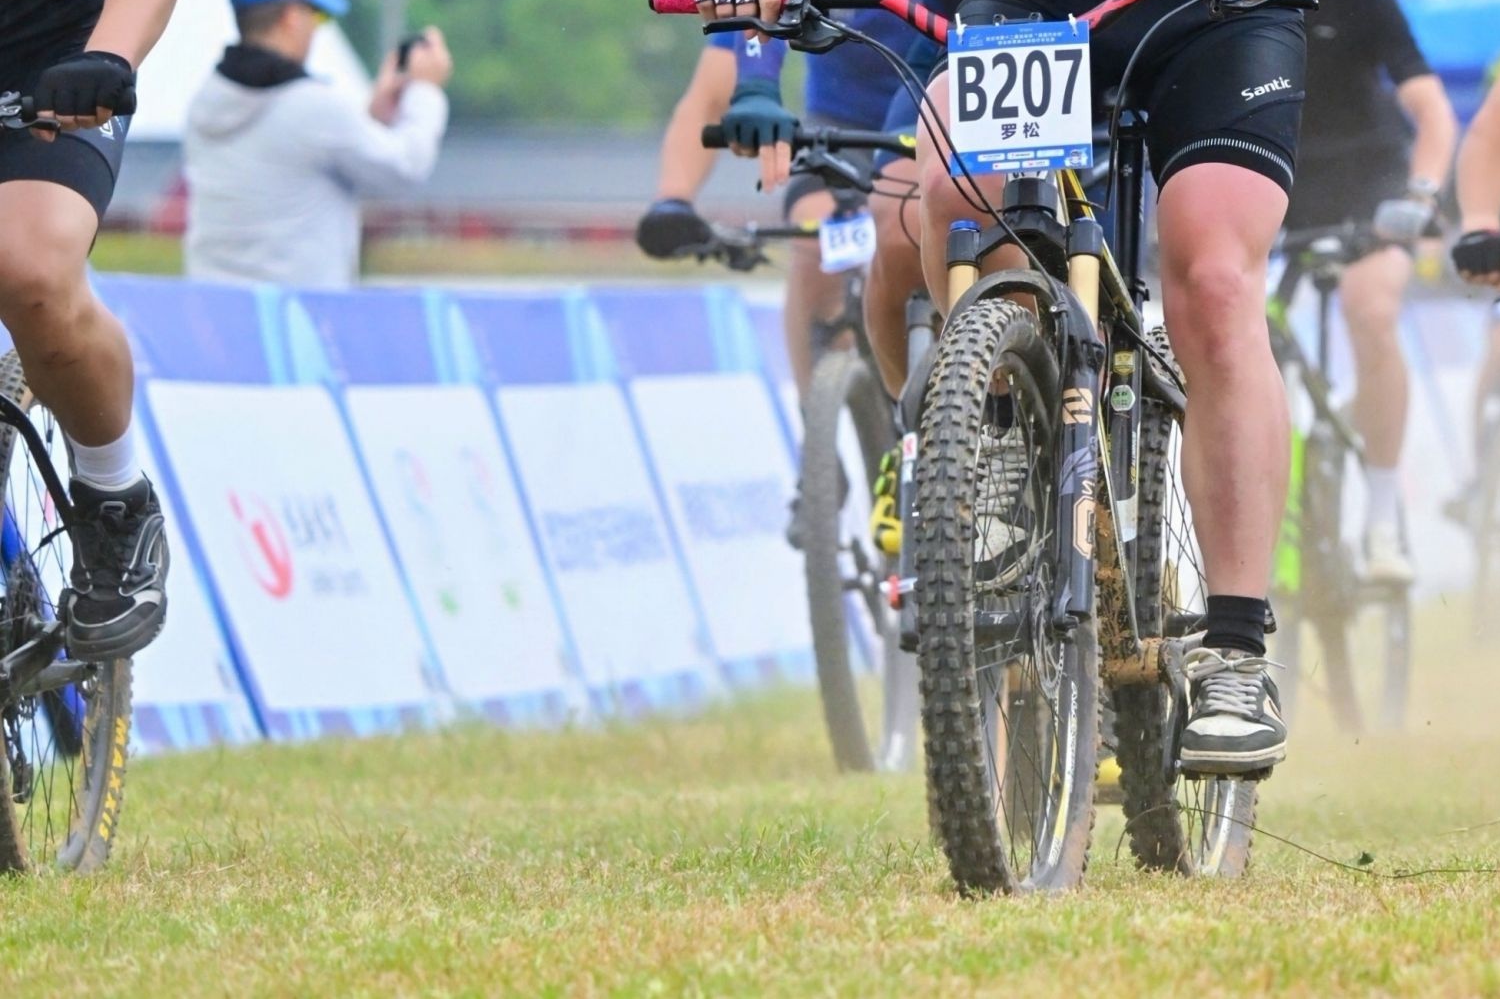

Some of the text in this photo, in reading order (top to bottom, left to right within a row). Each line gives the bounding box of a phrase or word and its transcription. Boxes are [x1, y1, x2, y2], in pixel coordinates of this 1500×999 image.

[957, 49, 1083, 122] B207
[1241, 76, 1292, 101] Santic
[1001, 122, 1040, 140] 罗松
